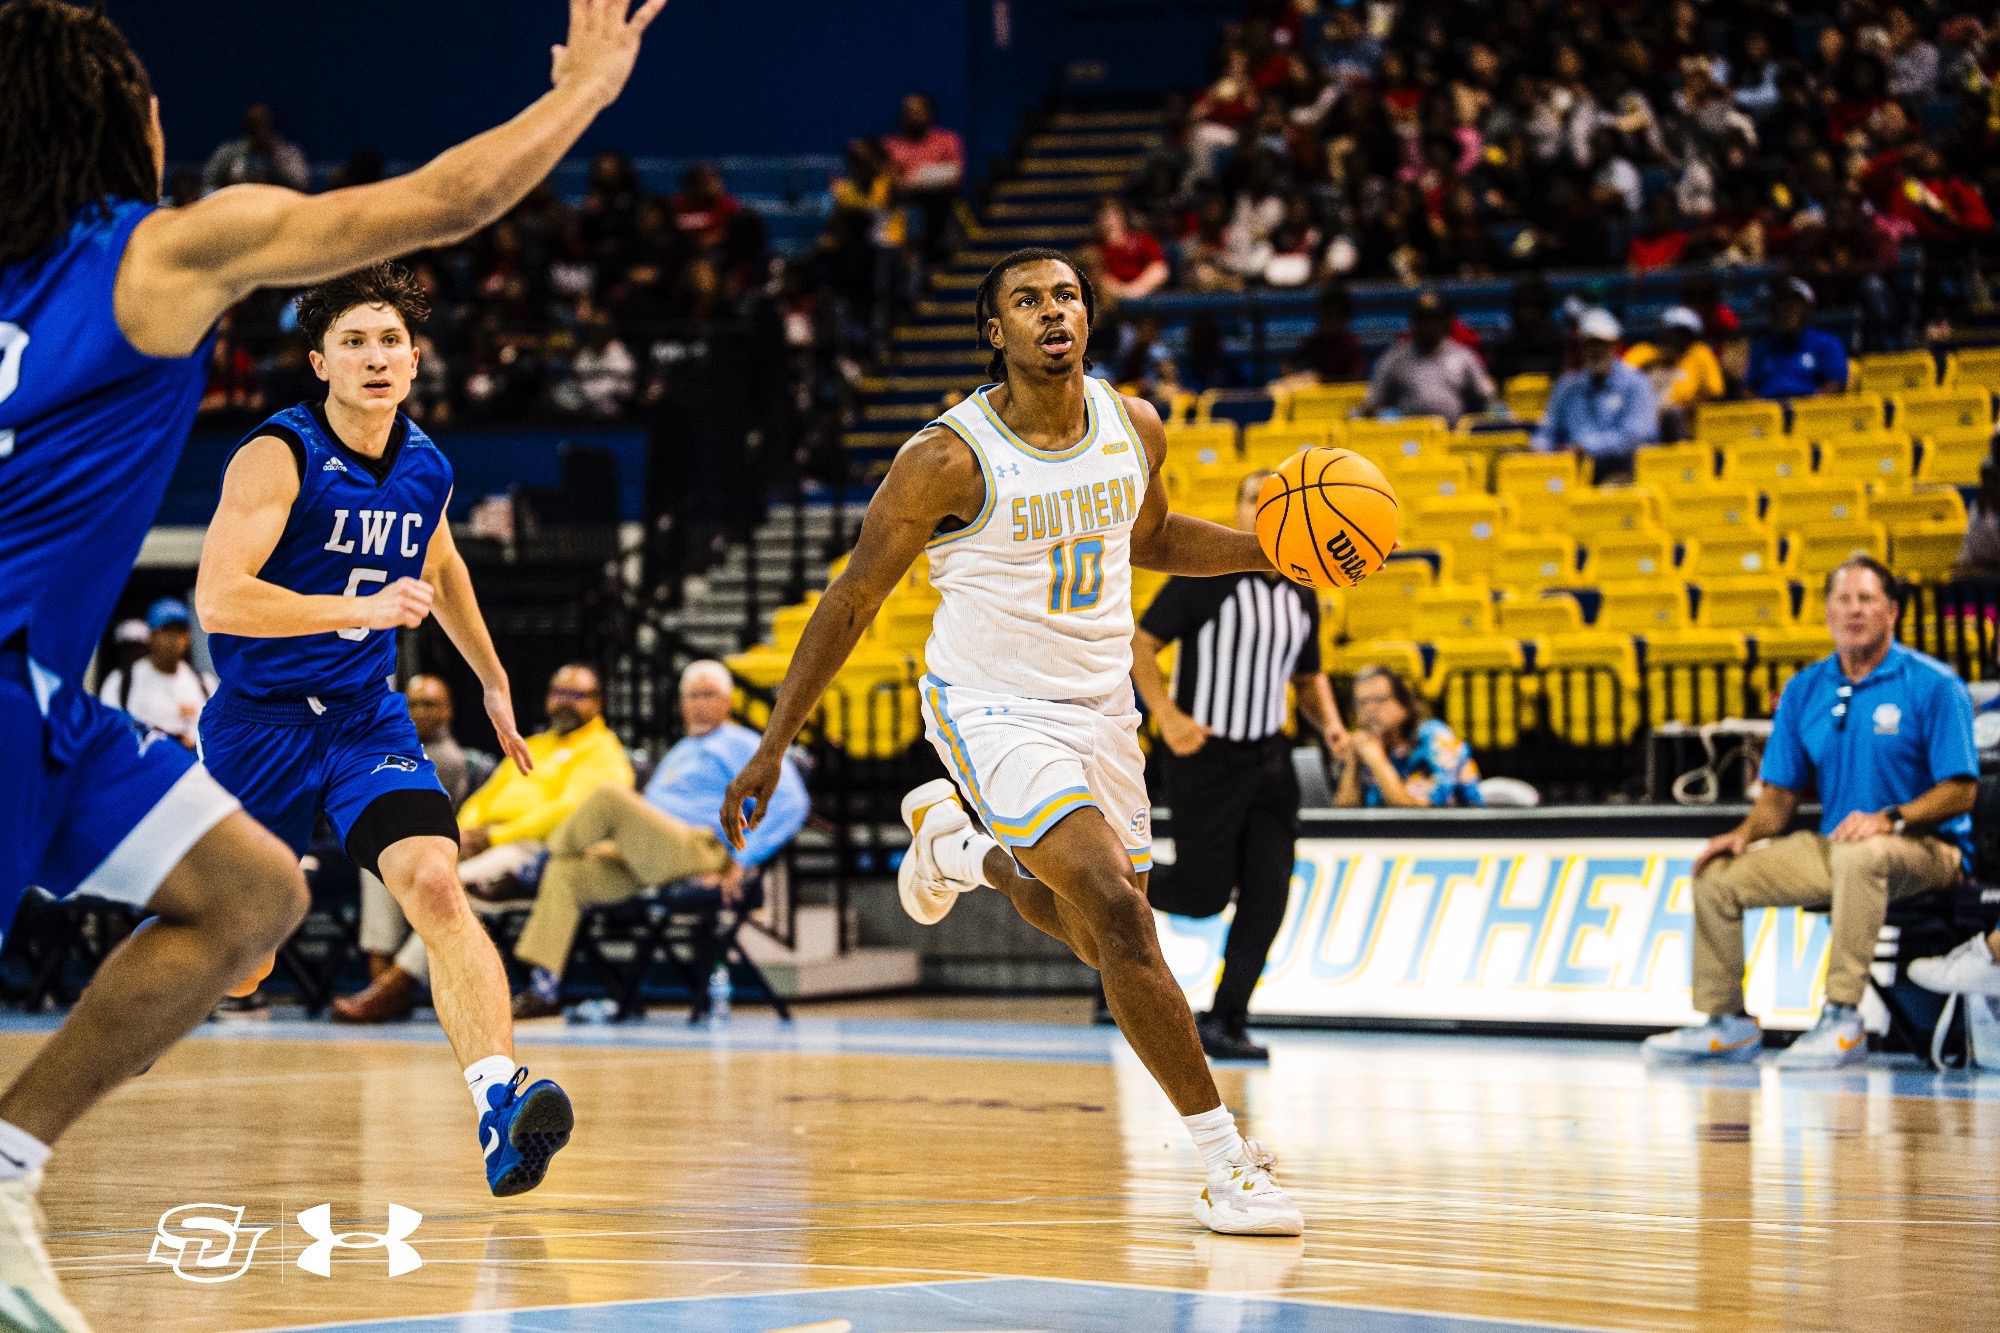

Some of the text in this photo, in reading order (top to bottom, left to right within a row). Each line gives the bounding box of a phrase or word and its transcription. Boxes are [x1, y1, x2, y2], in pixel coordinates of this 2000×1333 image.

[324, 509, 422, 558] LWC
[1012, 475, 1136, 541] SOUTHERN
[1048, 535, 1105, 614] 10
[1326, 529, 1367, 583] Wilso
